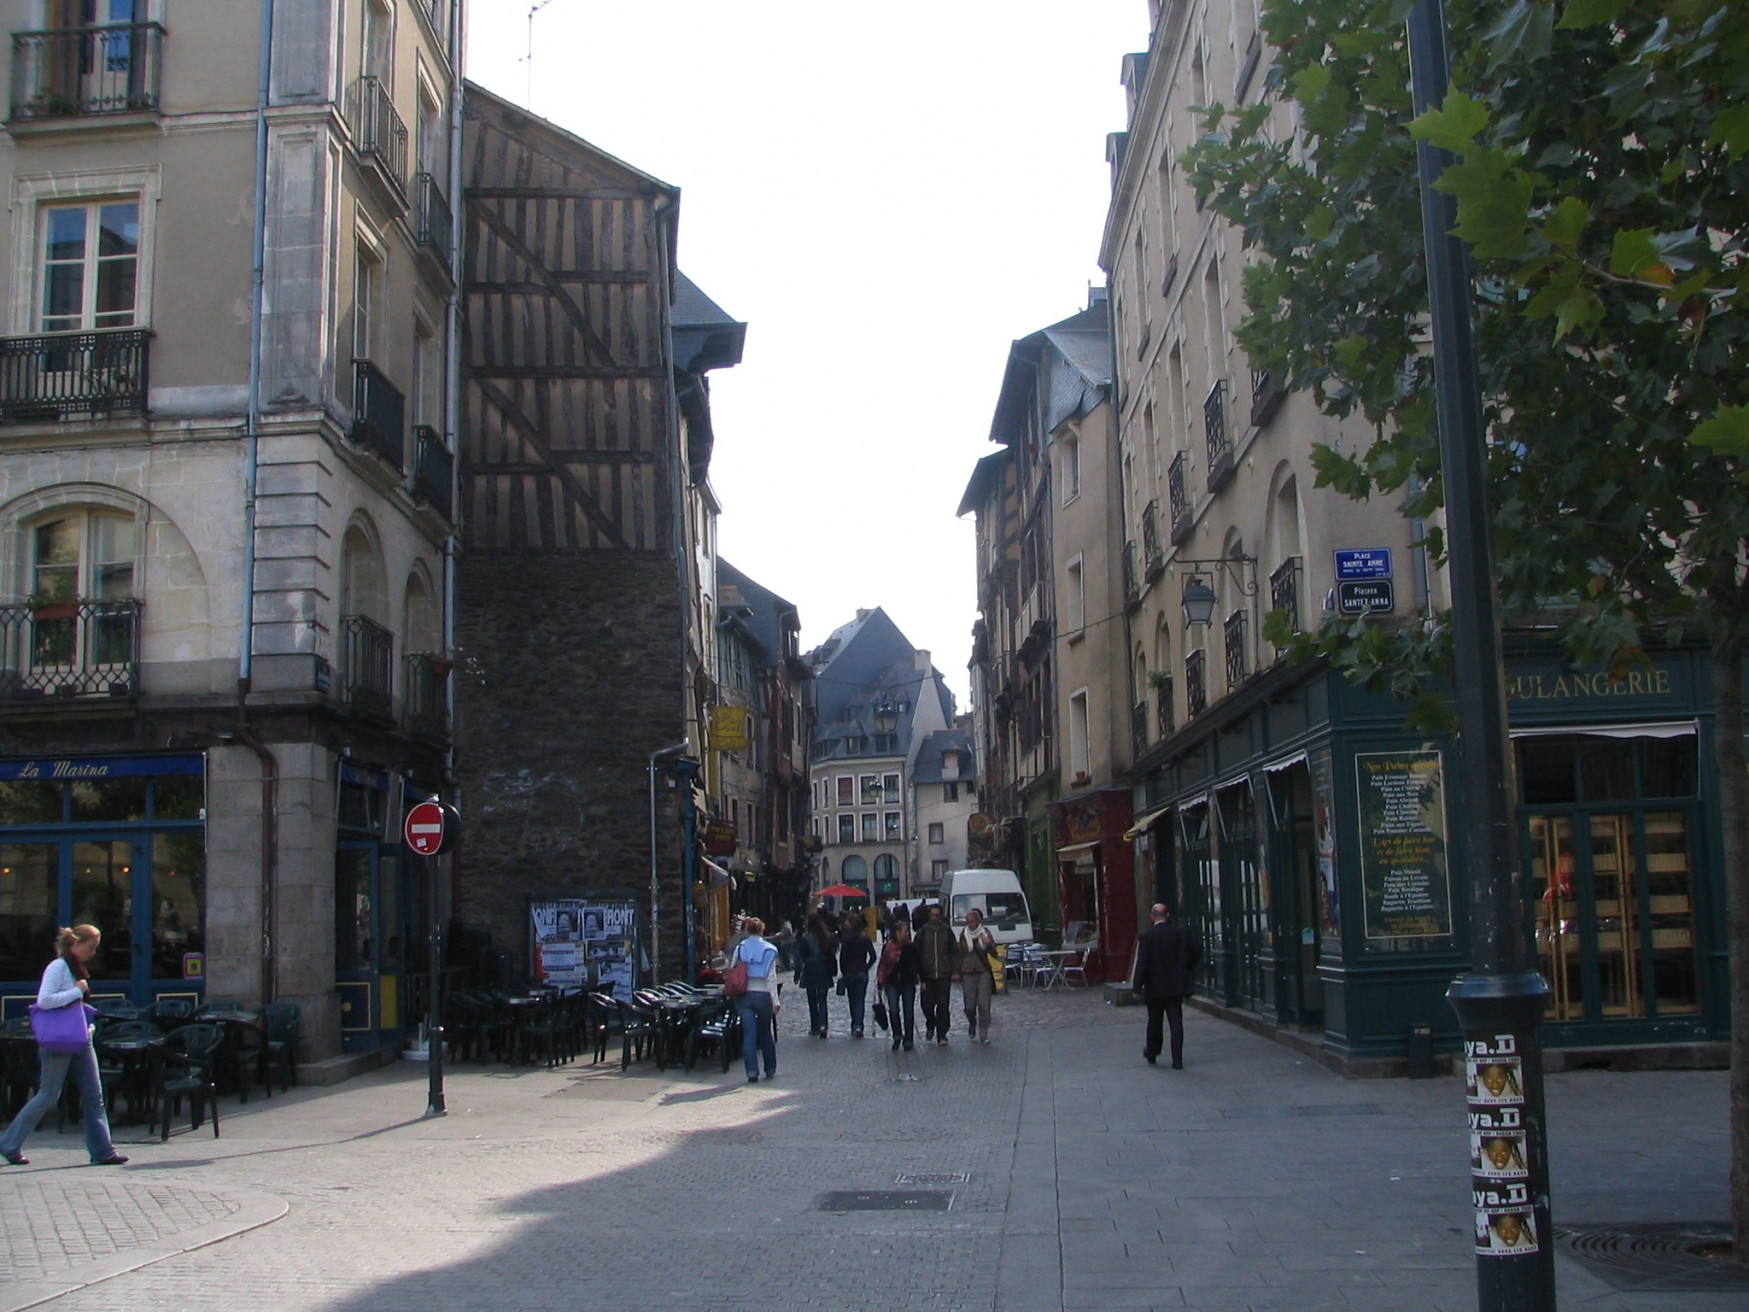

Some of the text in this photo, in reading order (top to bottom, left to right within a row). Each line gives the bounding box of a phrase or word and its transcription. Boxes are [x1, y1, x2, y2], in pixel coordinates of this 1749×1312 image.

[1342, 559, 1384, 568] SAINTE ANNE
[18, 760, 109, 777] La Marina
